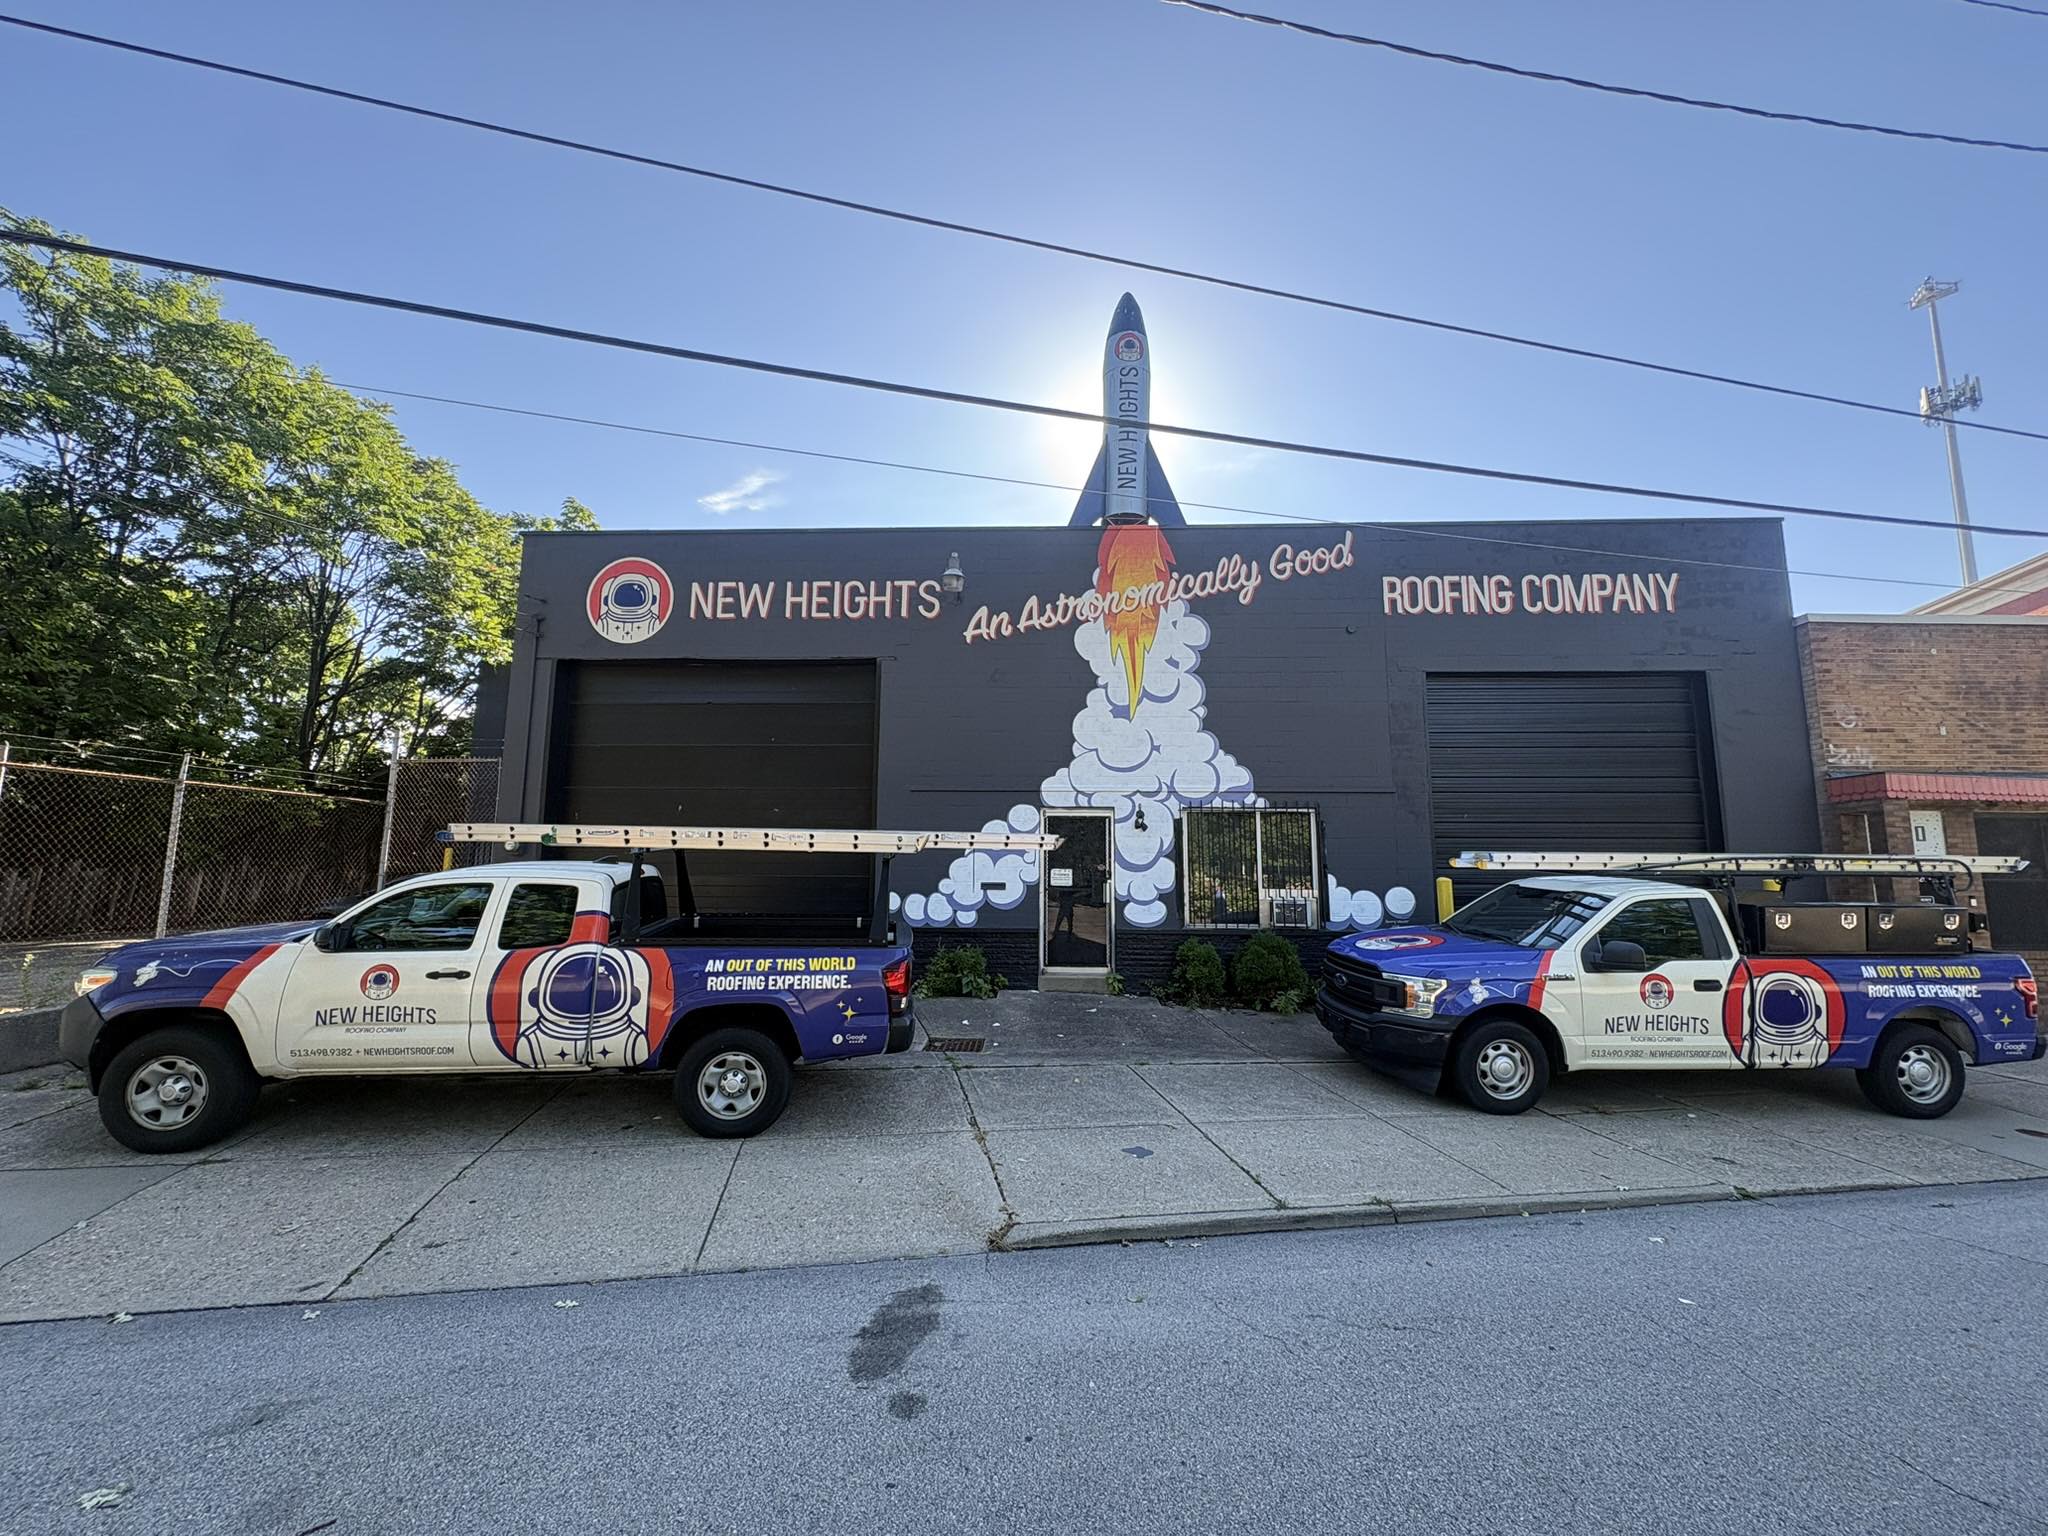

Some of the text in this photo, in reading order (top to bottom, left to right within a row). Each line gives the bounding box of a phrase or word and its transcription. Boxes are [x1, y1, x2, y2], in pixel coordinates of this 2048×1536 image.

[1117, 366, 1139, 489] NEW HIGHTS
[963, 530, 1355, 645] An Astronomically Good
[1382, 572, 1680, 616] ROOFING COMPANY
[689, 580, 942, 620] NEW HEIGHTS
[705, 957, 857, 973] AN OUT OF THIS WORLD
[1861, 966, 1981, 978] AN OUT OF THIS WORLD
[707, 974, 852, 991] ROOFING EXPERIENCE.
[1867, 984, 1982, 998] ROOFING EXPERIENCE.
[315, 1005, 437, 1027] NEW HEIGHTS
[1605, 1015, 1710, 1035] NEW HEIGHTS
[845, 1033, 868, 1041] Google
[363, 1046, 455, 1057] NEWHEIGHTSROOF.COM
[1648, 1050, 1728, 1059] NEWHEIGHTSROOF.COM
[2002, 1042, 2028, 1051] Google
